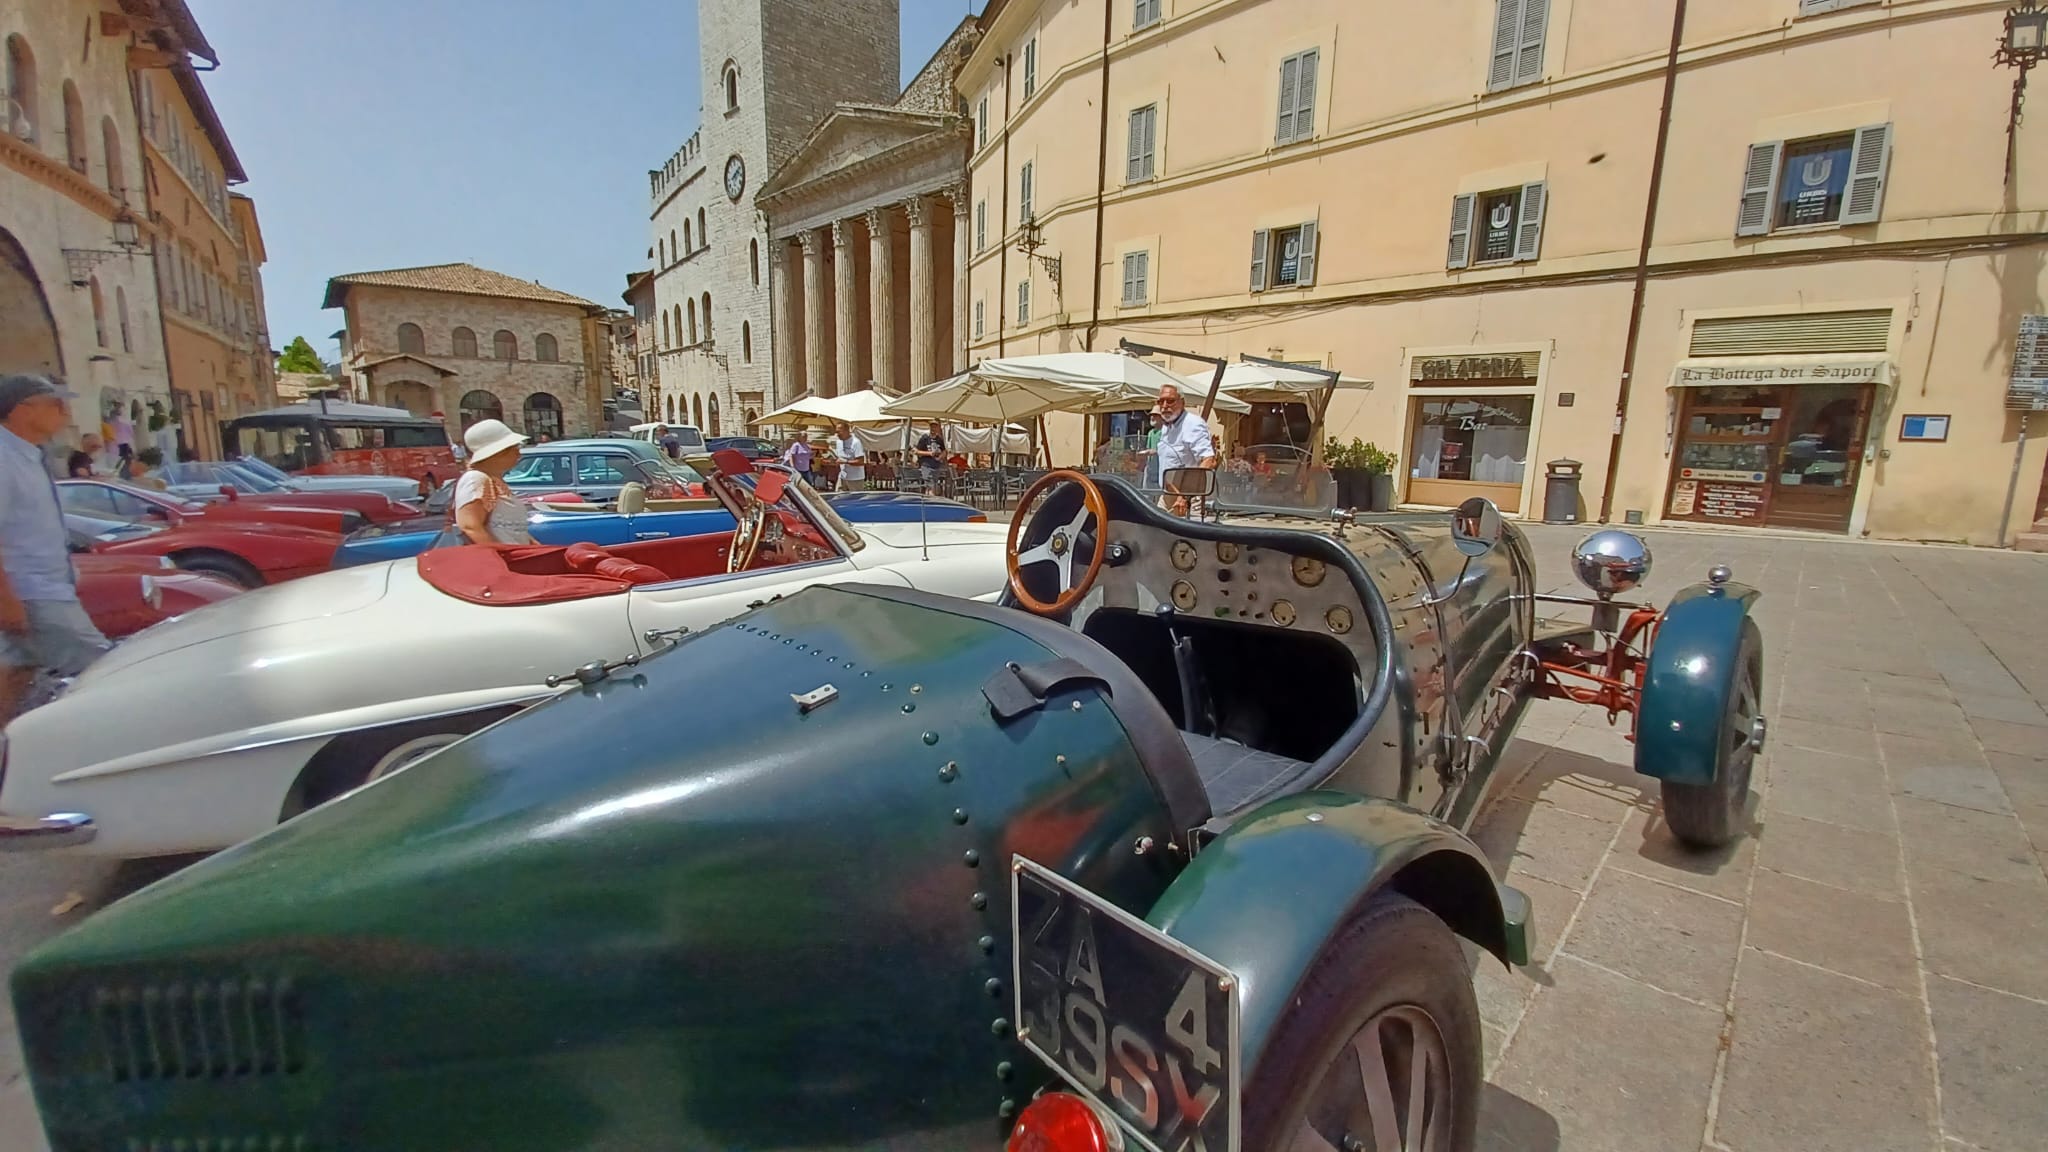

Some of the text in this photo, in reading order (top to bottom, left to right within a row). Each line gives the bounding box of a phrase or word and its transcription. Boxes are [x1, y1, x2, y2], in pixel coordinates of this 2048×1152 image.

[1682, 365, 1877, 382] La Bottega dei Sapori
[1459, 415, 1489, 431] Bar
[1165, 969, 1222, 1076] 4
